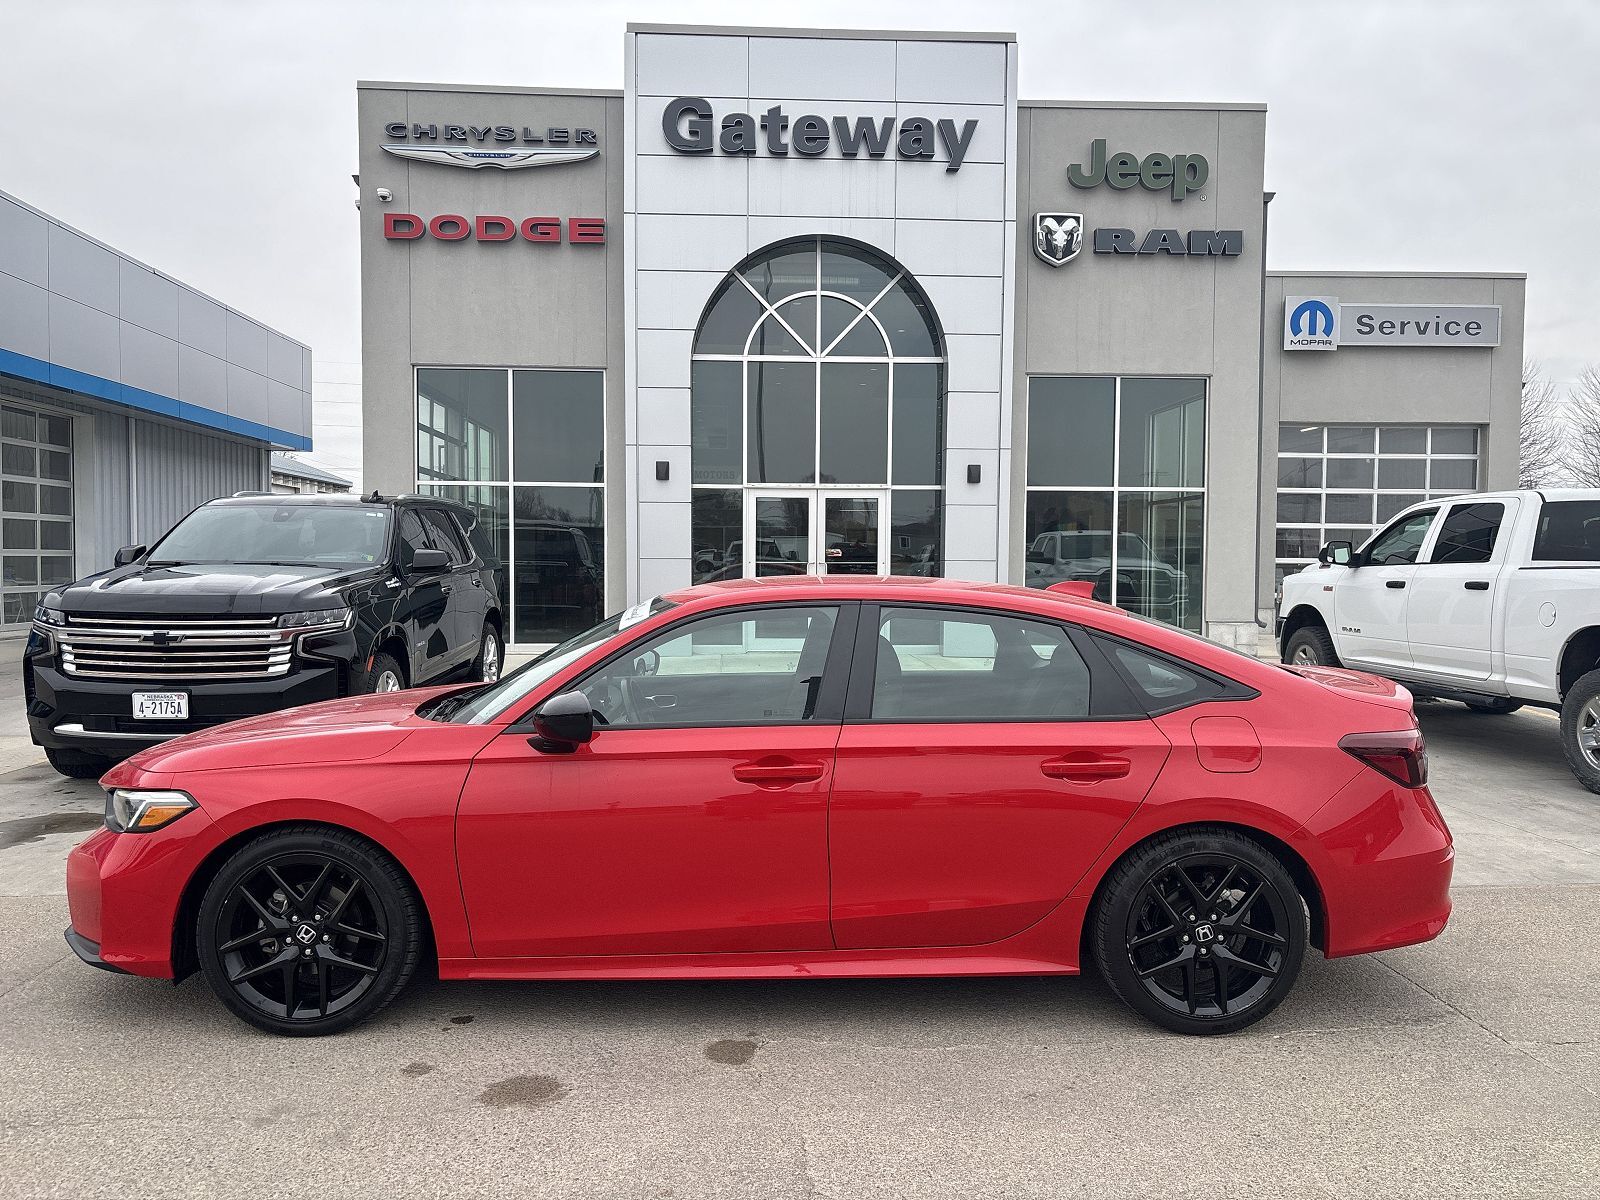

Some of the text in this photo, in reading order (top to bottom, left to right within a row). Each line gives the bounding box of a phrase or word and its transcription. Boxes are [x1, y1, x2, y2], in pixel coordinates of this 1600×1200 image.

[384, 122, 598, 144] CHRYSLER
[662, 96, 979, 172] Gateway
[1067, 138, 1209, 200] Jeep
[384, 212, 606, 245] DODGE
[1093, 227, 1244, 256] RAM
[1356, 314, 1482, 337] Service
[139, 702, 182, 714] 4-2175A
